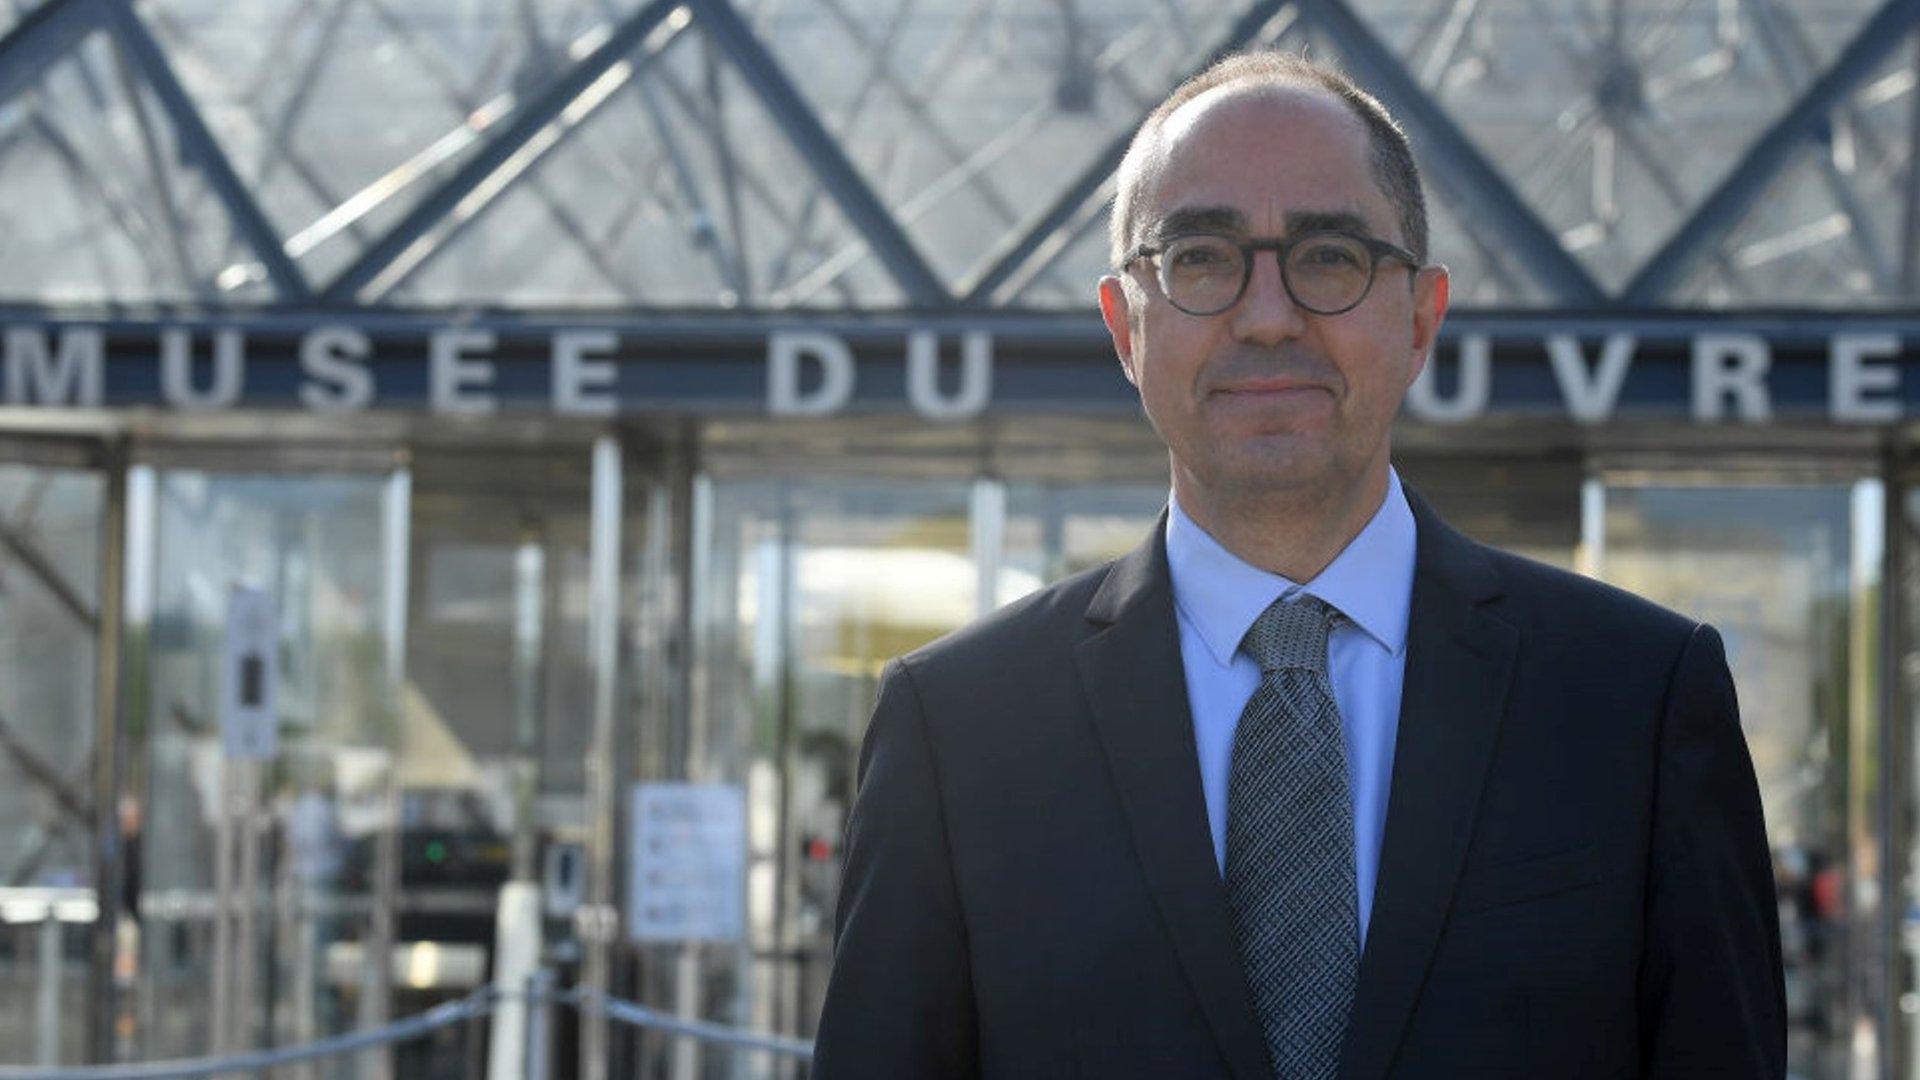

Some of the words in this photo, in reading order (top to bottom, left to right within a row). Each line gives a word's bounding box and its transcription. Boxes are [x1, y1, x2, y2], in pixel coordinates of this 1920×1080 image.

[3, 309, 618, 415] MUSÉE
[767, 329, 993, 419] DU
[1406, 332, 1904, 423] UVRE
